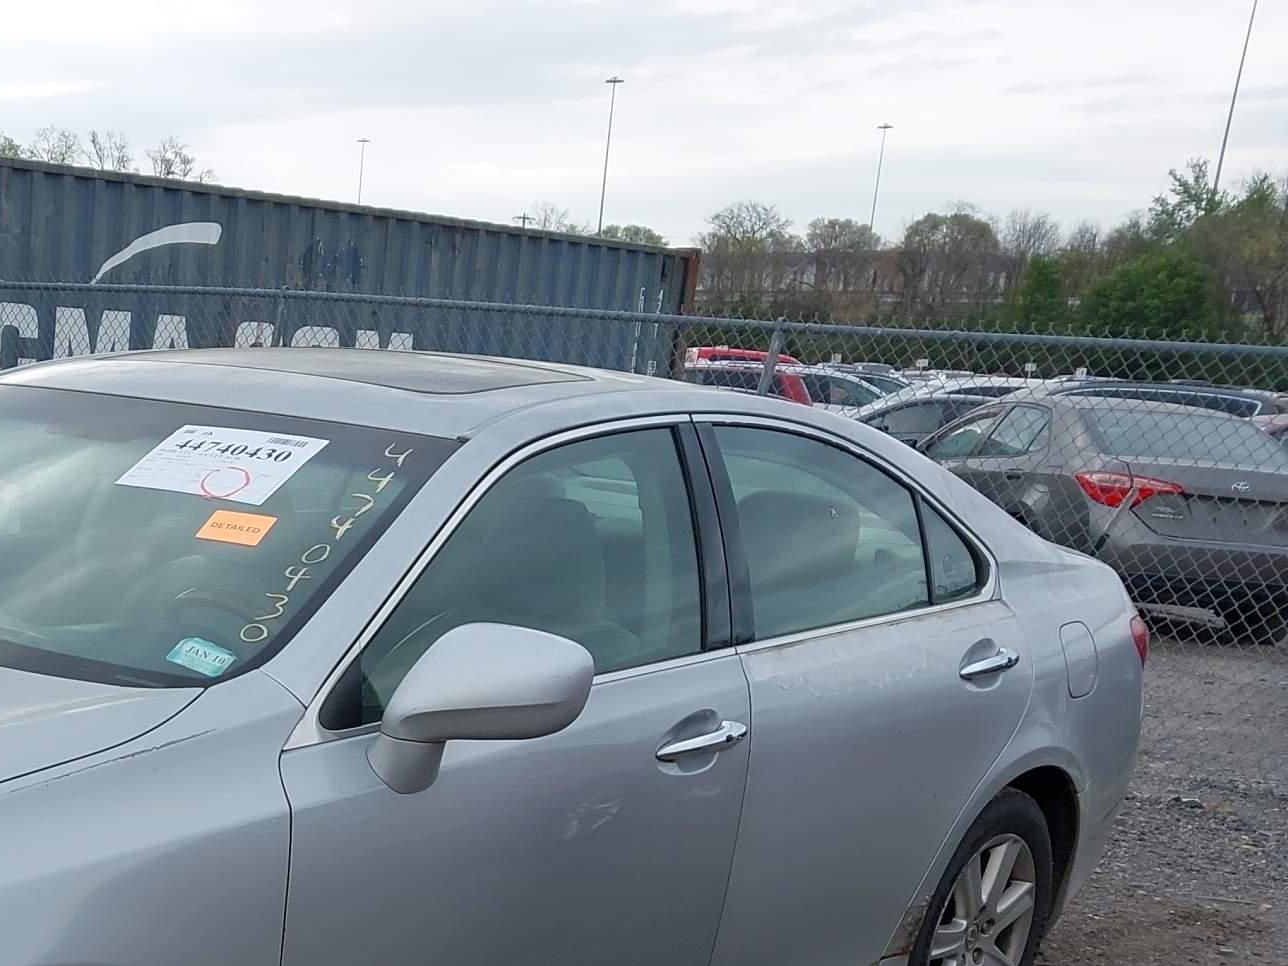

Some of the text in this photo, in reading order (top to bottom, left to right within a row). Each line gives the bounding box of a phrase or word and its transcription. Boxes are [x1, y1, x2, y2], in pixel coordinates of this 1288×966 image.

[175, 439, 293, 463] 44740430
[210, 522, 261, 534] DETAILED
[184, 645, 212, 660] JAN
